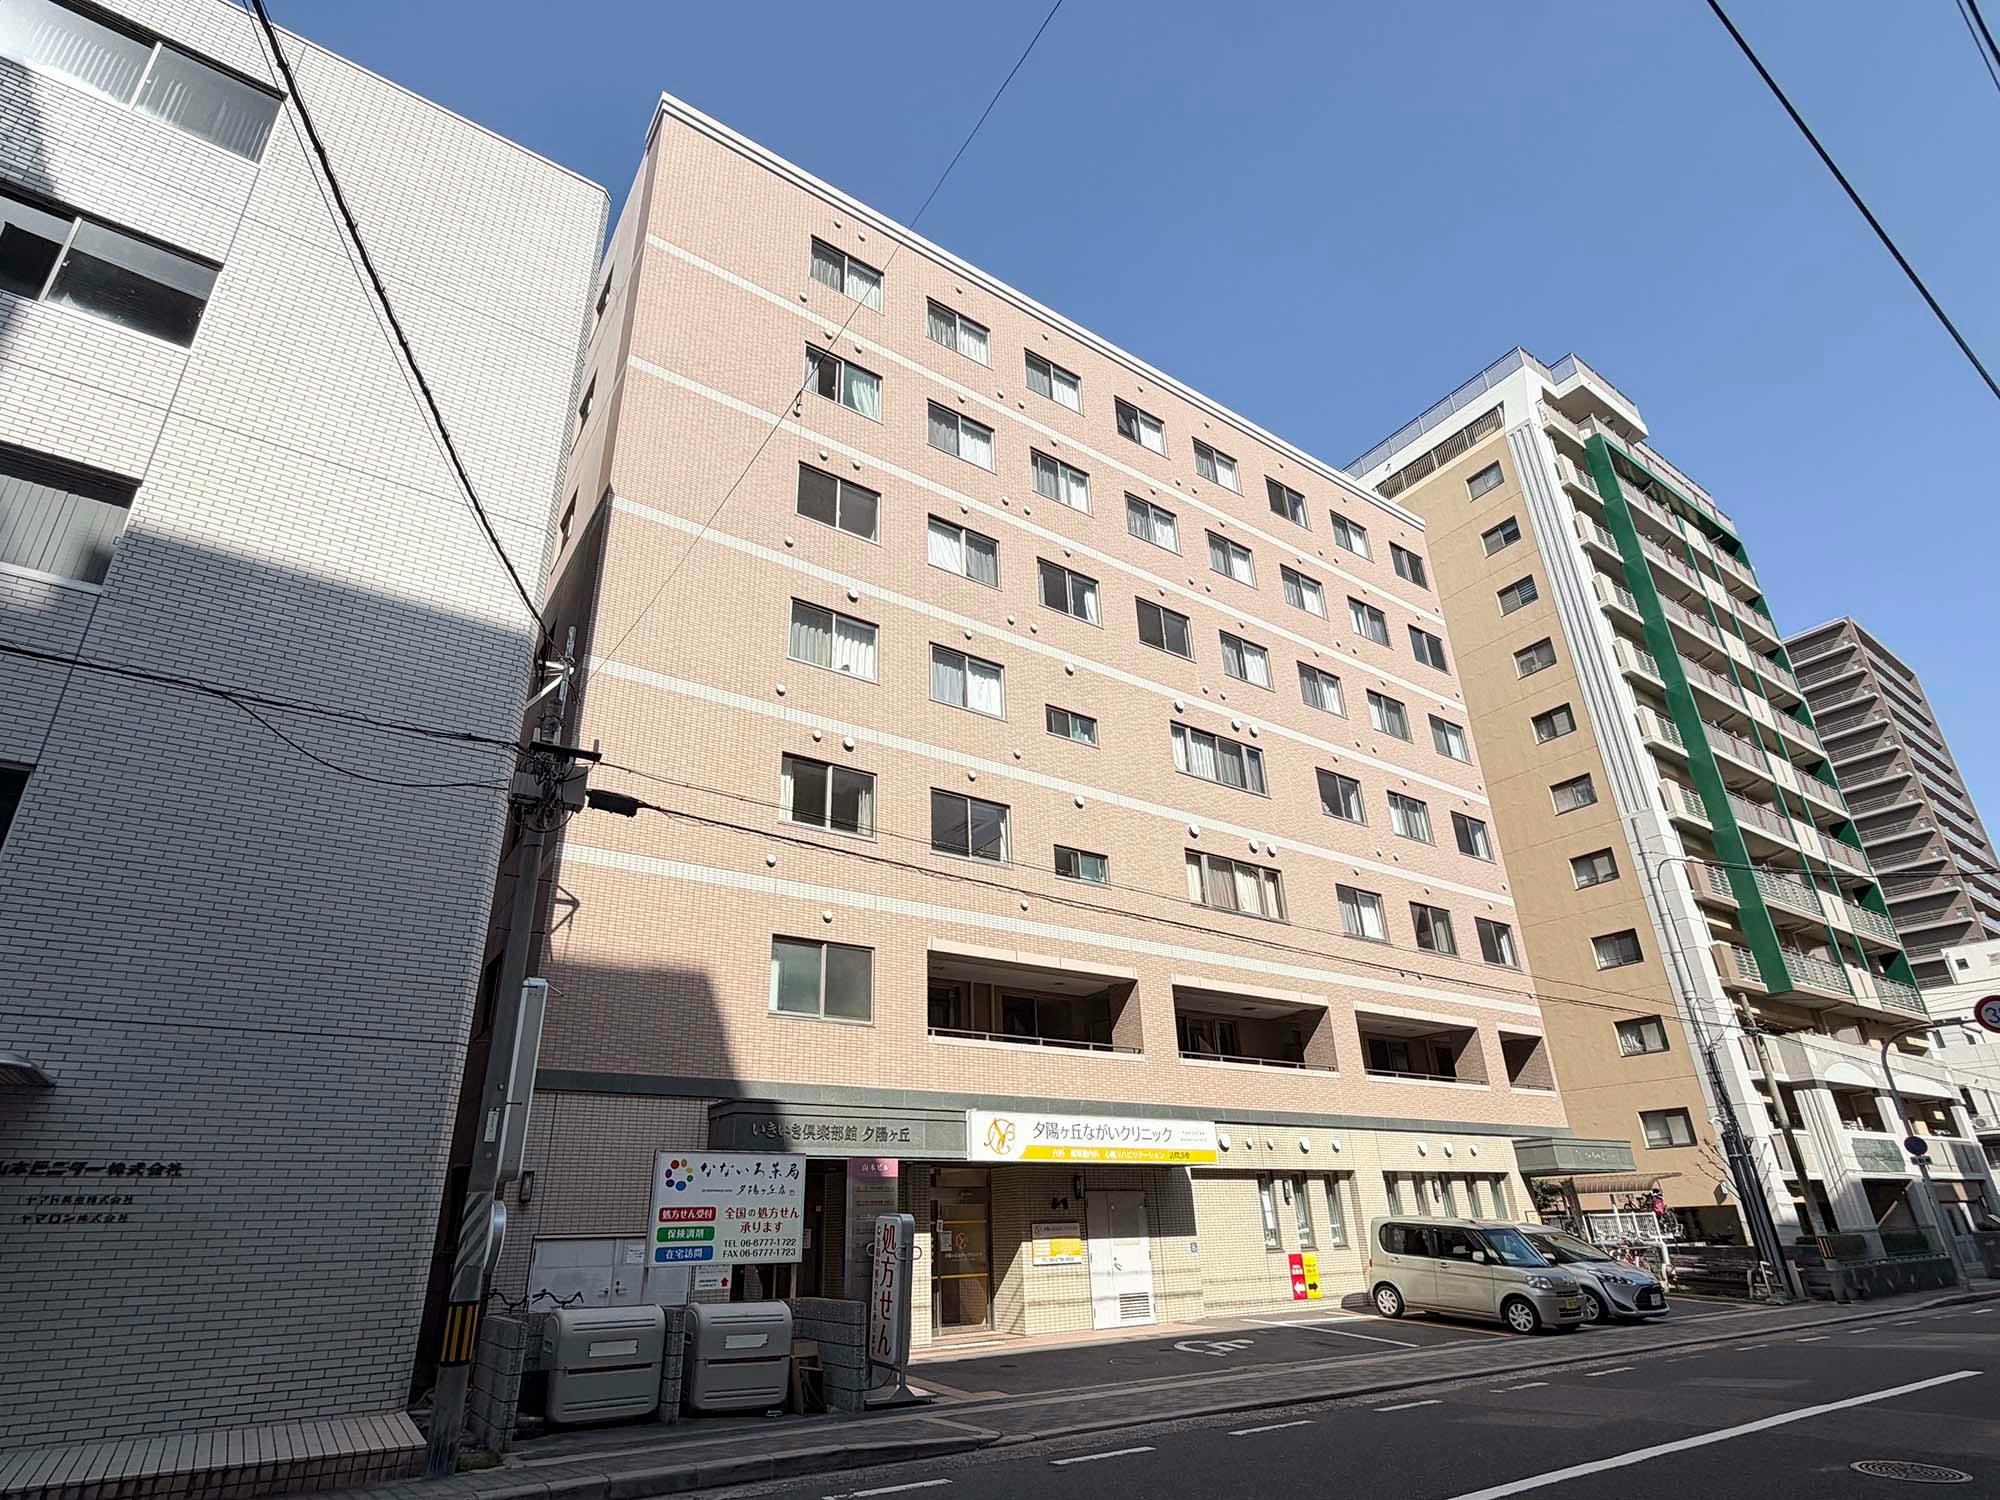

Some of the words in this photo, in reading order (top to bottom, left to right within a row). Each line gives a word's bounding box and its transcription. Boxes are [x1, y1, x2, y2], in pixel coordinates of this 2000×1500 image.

[752, 1121, 857, 1142] いきいき倶楽部館
[862, 1126, 911, 1143] 夕陽ヶ丘
[1032, 1121, 1172, 1143] 夕陽ヶ丘ながいクリニック
[700, 1161, 800, 1180] なないろ薬局
[662, 1208, 713, 1220] 処方せん受付
[724, 1207, 800, 1220] 全国の処方せん
[667, 1228, 705, 1240] 保険調剤
[740, 1221, 783, 1234] 承ります
[723, 1239, 738, 1248] TEL
[665, 1248, 703, 1260] 在宅訪問
[722, 1250, 738, 1258] FAX
[879, 1223, 897, 1357] 処方せん
